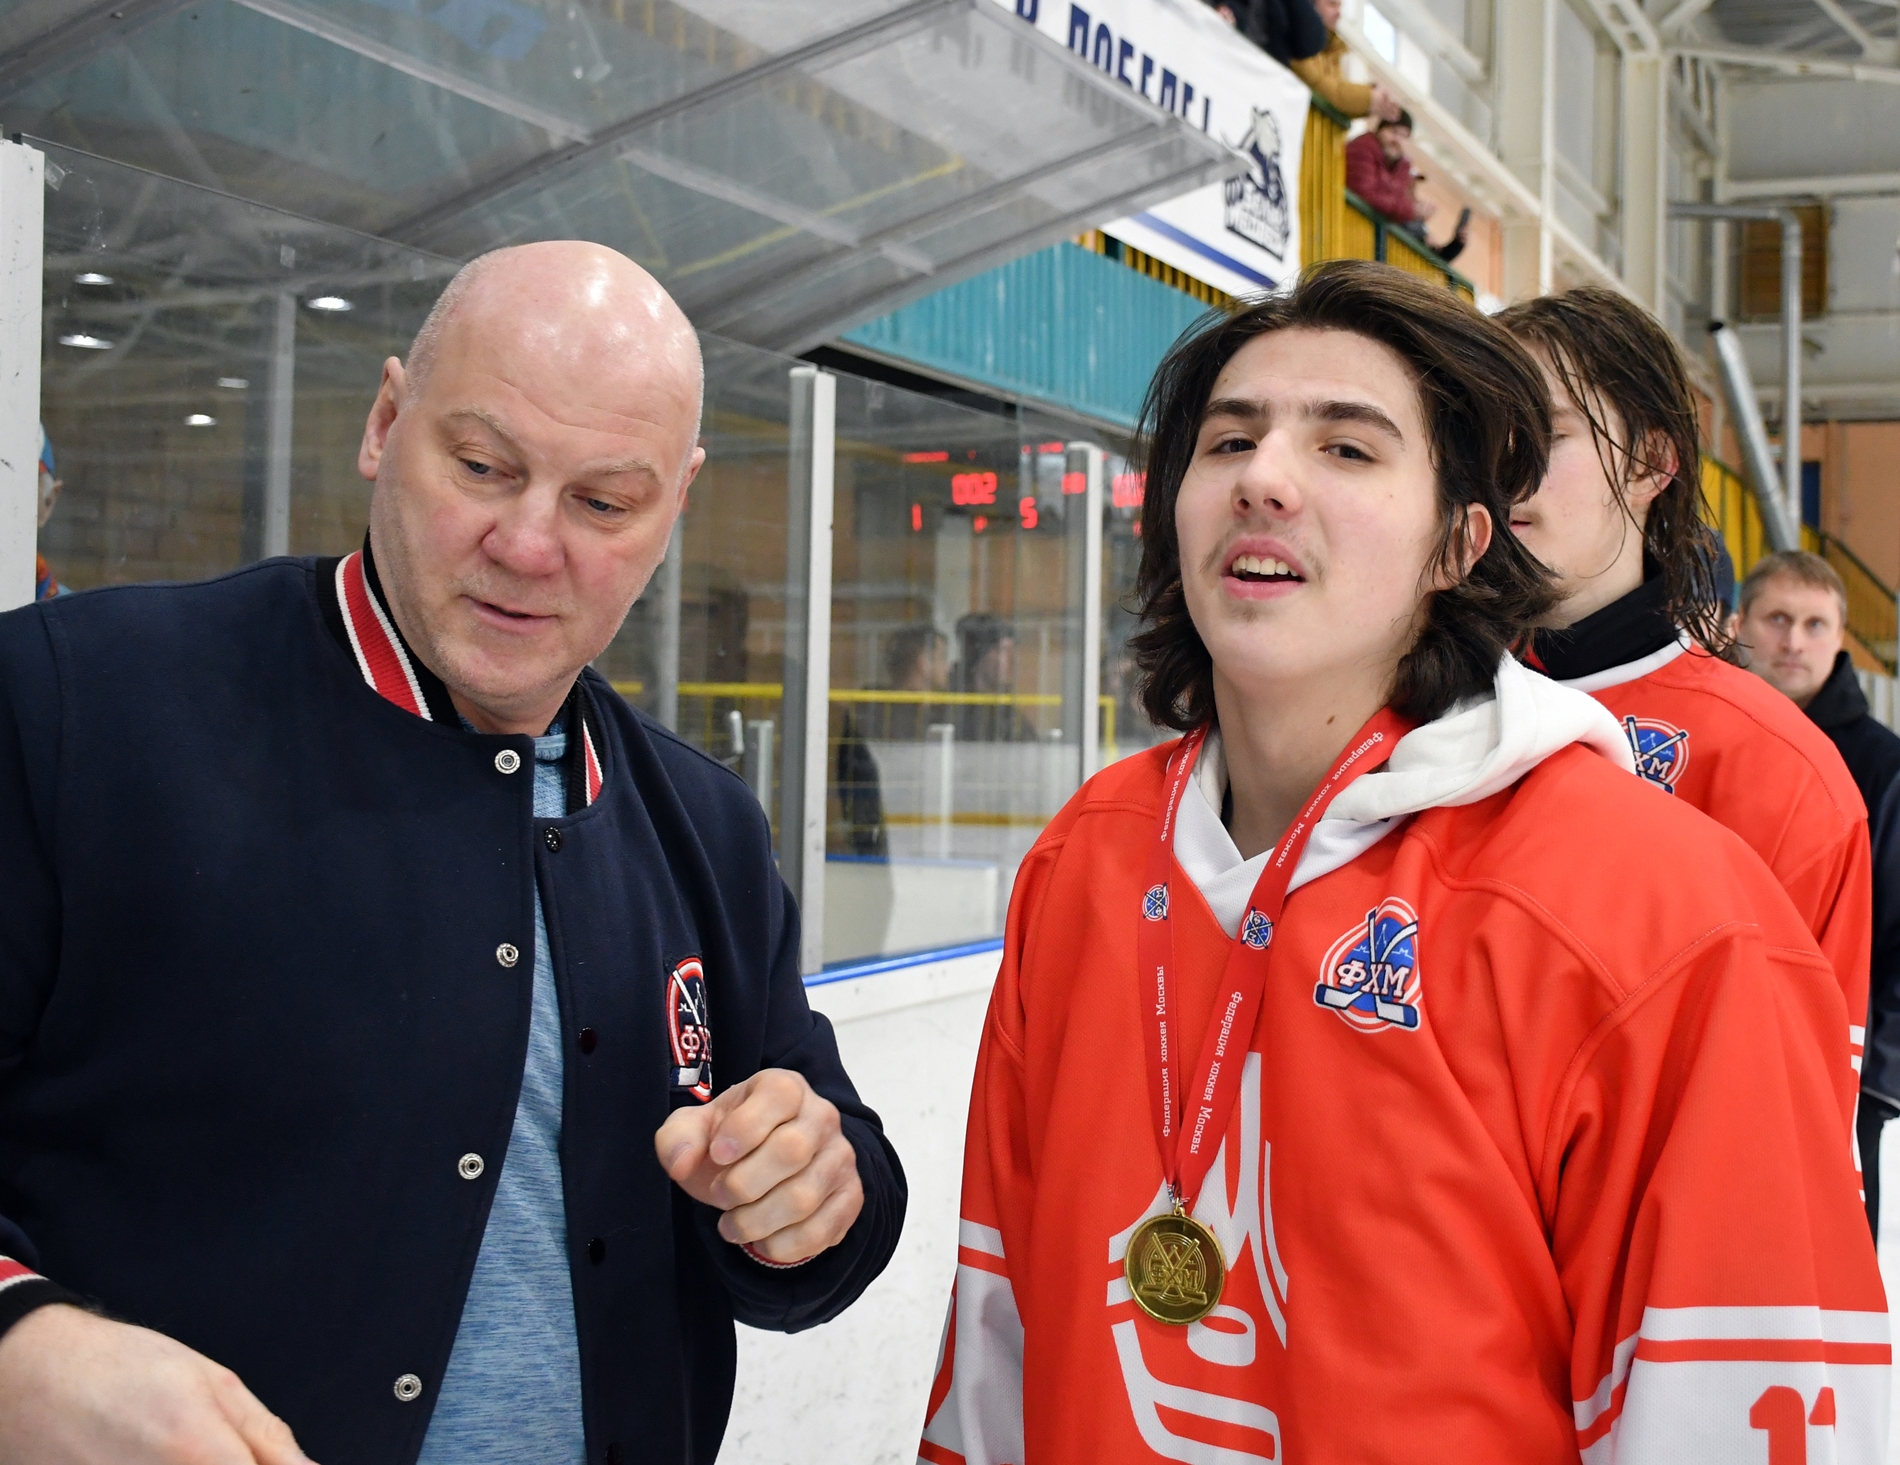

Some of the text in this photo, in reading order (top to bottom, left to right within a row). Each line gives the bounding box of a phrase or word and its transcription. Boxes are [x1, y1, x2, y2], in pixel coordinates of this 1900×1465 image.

[1275, 731, 1384, 868] Федерация хоккея Москвы
[1634, 751, 1672, 780] ХМ
[1337, 959, 1411, 998] ФХМ
[1156, 965, 1171, 1137] Федерация хоккея Москвы
[1190, 991, 1243, 1155] Федерация хоккея Москвы
